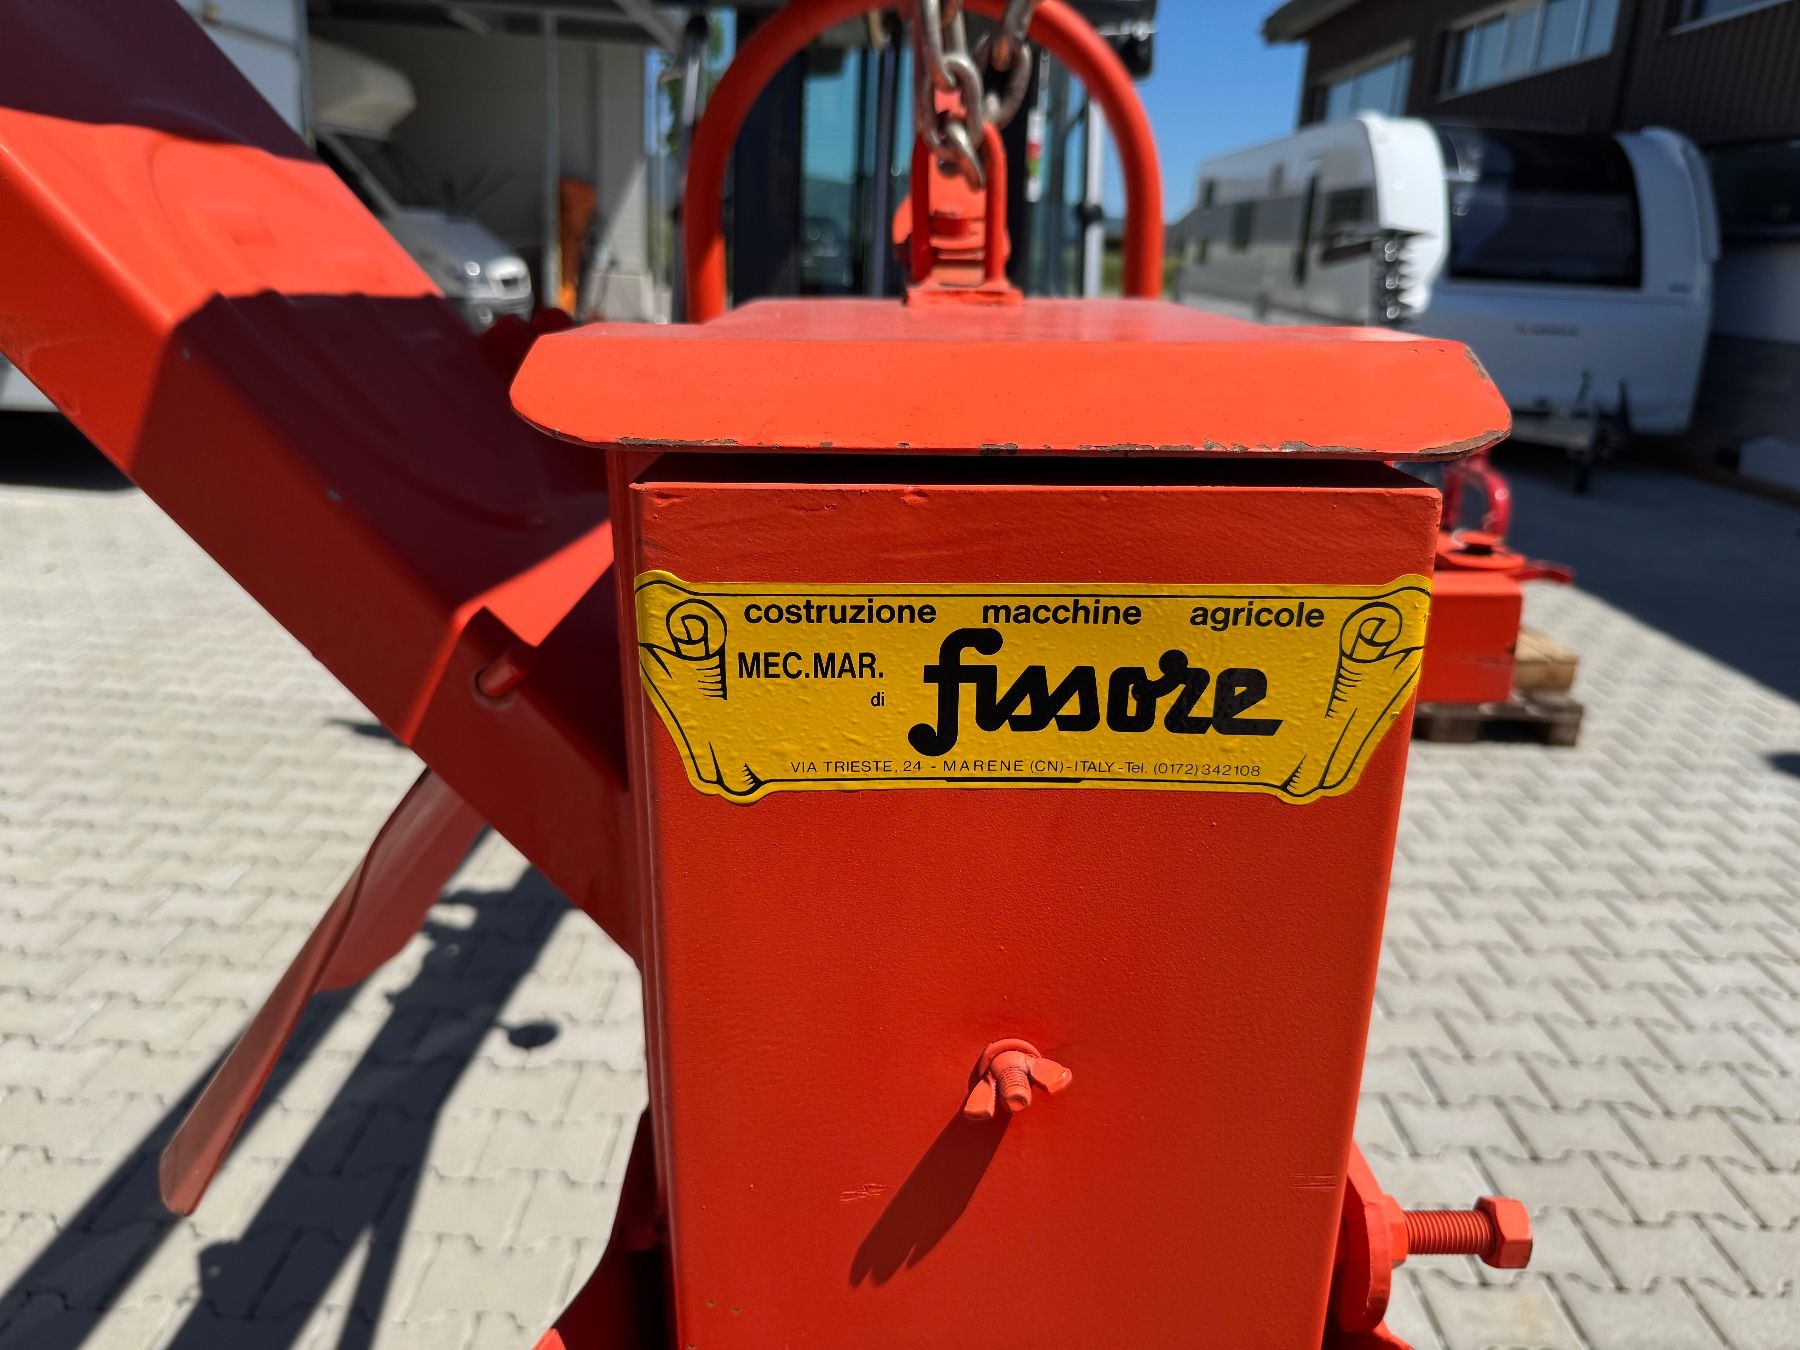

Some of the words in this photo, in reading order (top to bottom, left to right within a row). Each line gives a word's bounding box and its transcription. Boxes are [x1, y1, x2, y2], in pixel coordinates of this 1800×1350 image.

[744, 598, 937, 624] costruzione
[982, 599, 1142, 625] macchine
[1190, 601, 1325, 632] agricole
[738, 651, 884, 679] MEC.MAR.
[870, 692, 885, 707] di
[908, 627, 1284, 757] fissore
[790, 761, 818, 773] VIA
[823, 760, 898, 774] TRIESTE,
[903, 760, 922, 772] 24
[943, 760, 1024, 773] MARENE
